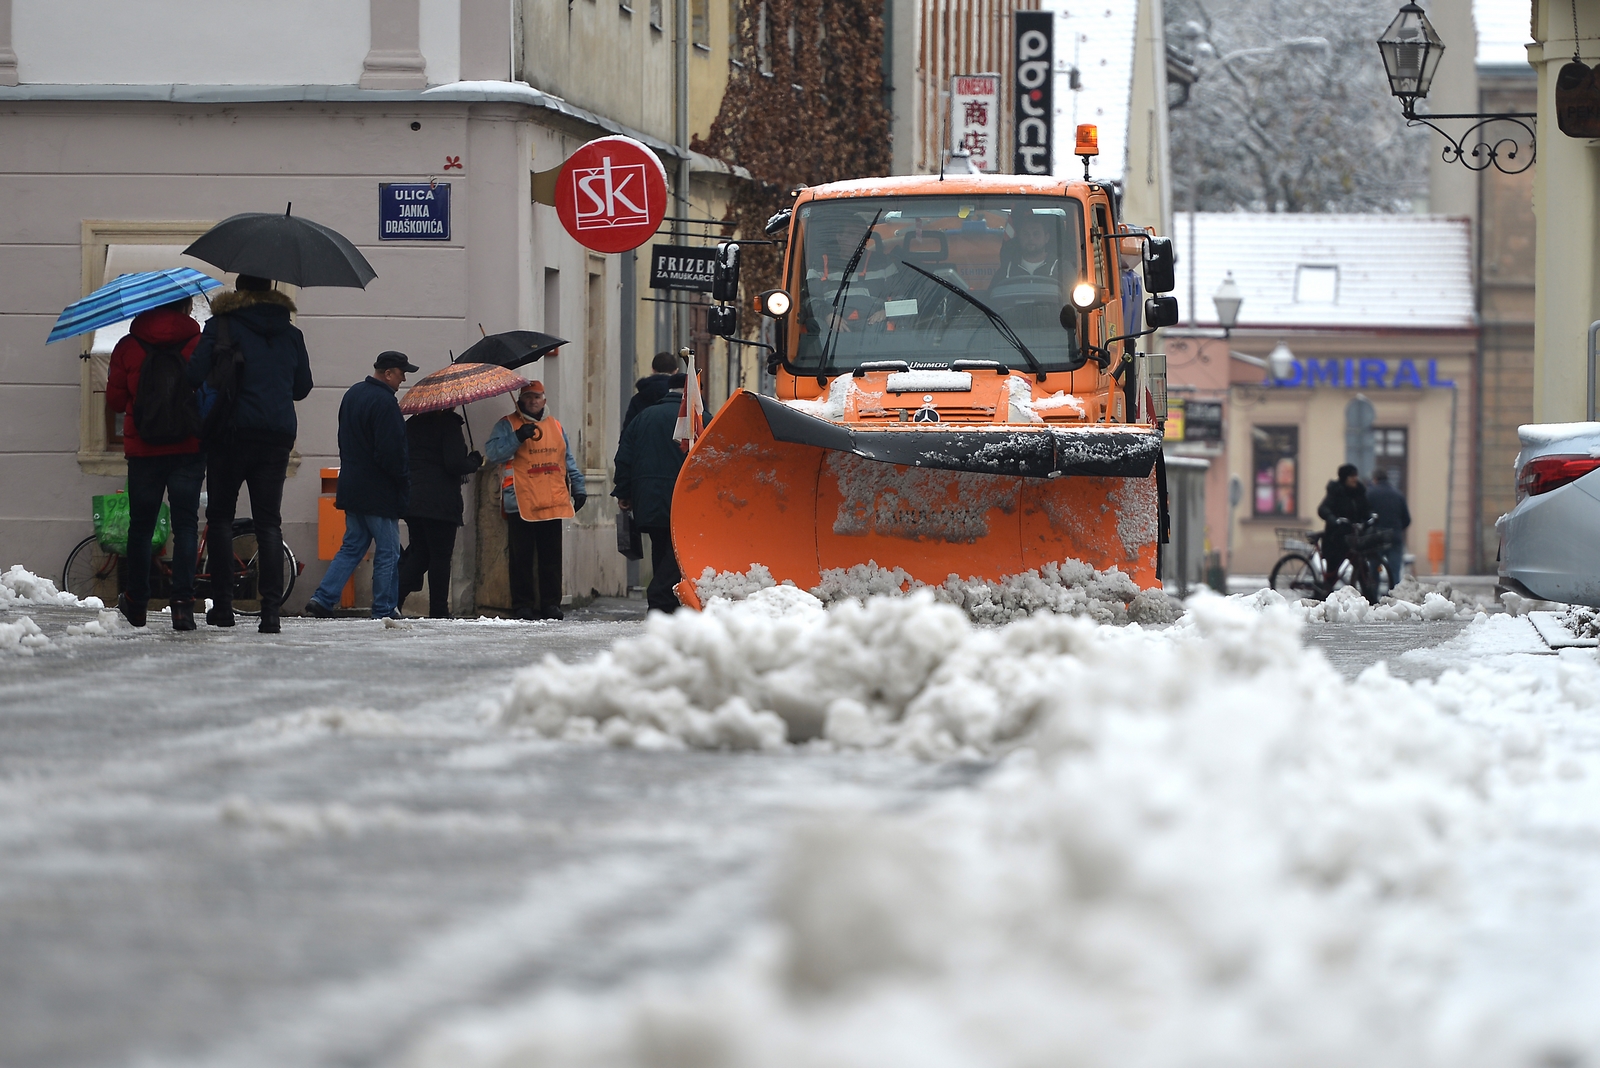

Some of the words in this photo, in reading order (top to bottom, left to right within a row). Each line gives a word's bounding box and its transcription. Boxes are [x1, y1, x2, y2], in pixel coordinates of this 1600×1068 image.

[395, 190, 435, 200] ULICA
[399, 204, 430, 218] JANKA
[385, 218, 444, 234] DRAŠKOVIĆA
[657, 255, 716, 274] FRIZER
[656, 270, 669, 279] ZA
[1263, 357, 1456, 389] DMIRAL
